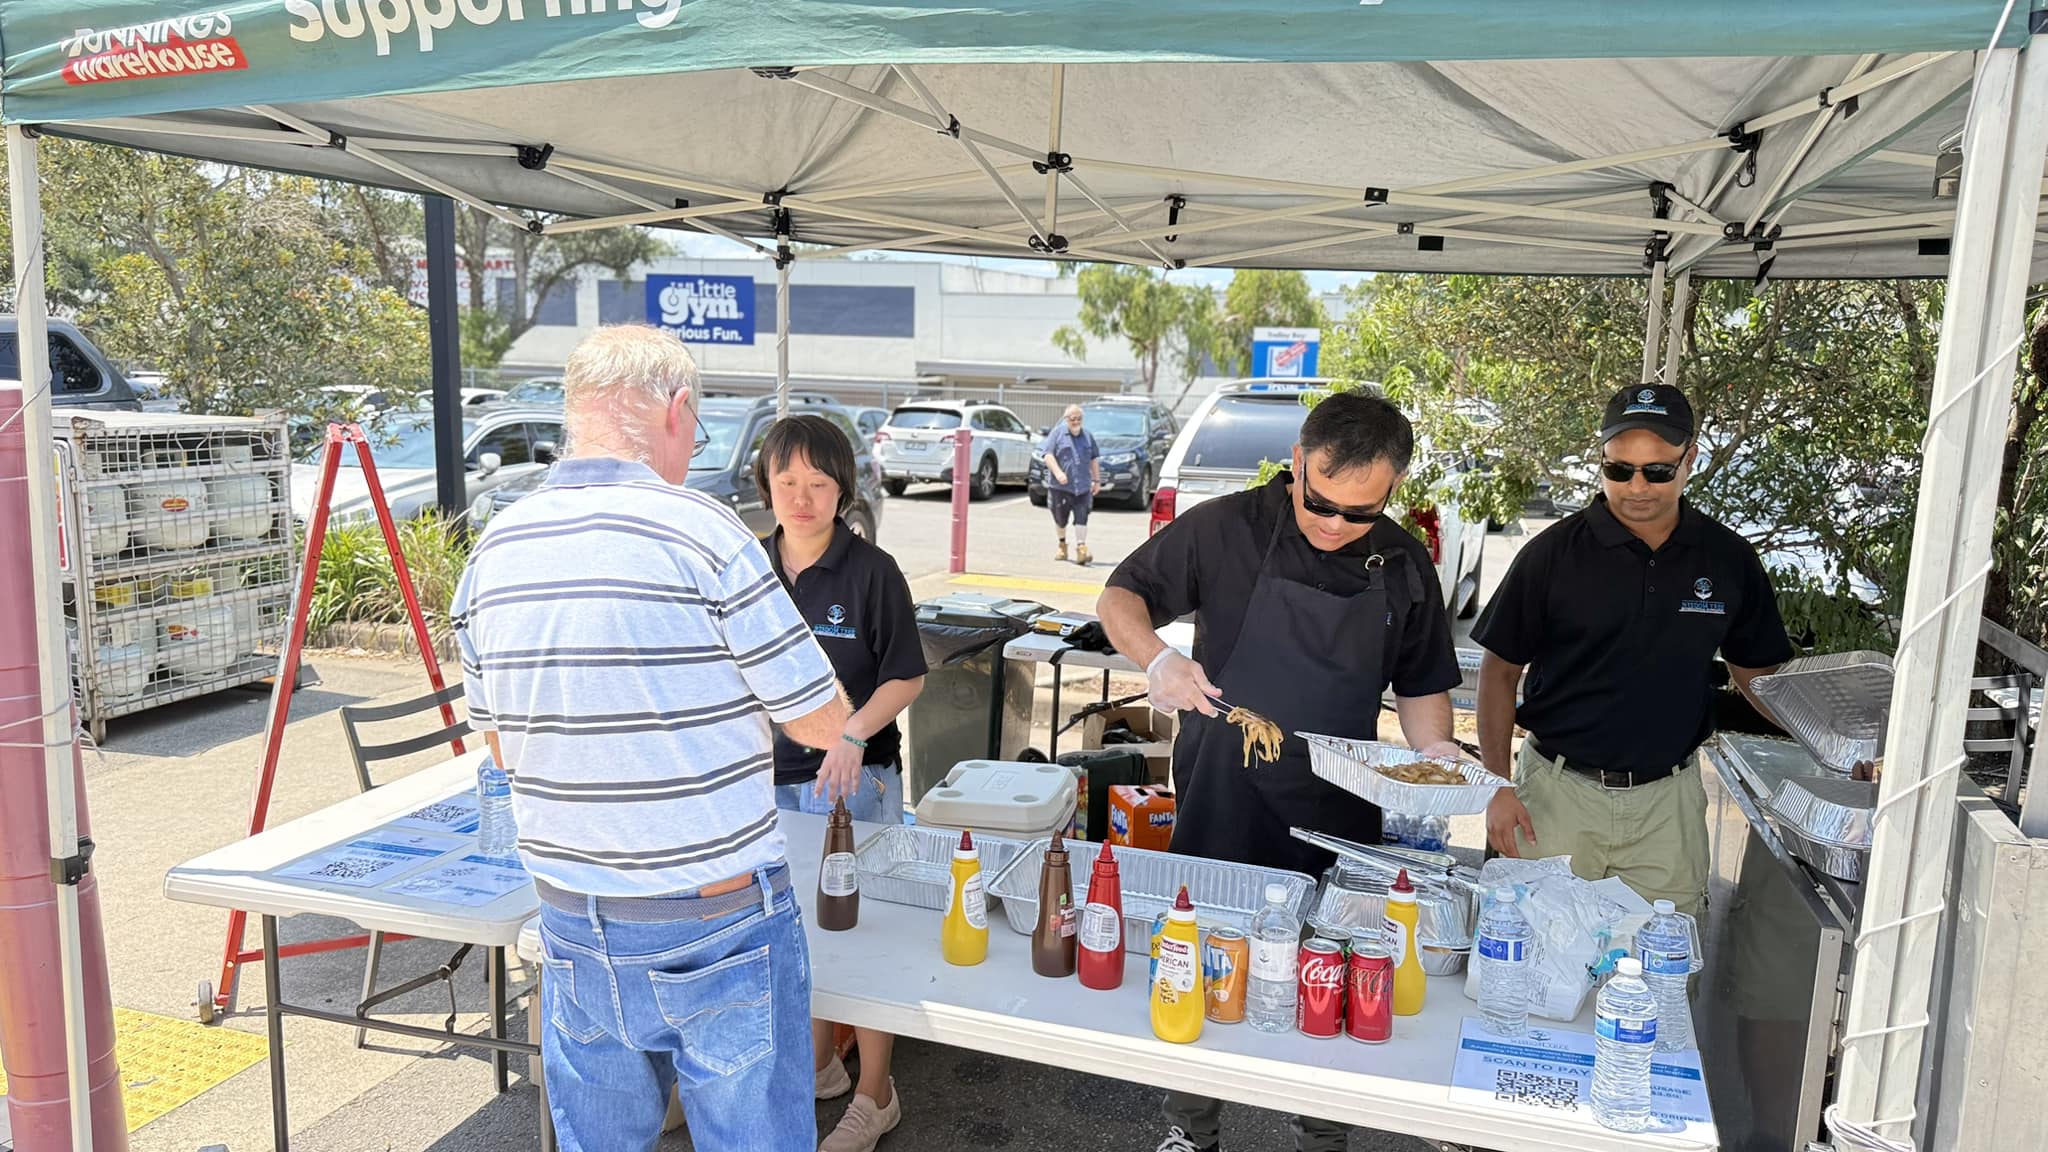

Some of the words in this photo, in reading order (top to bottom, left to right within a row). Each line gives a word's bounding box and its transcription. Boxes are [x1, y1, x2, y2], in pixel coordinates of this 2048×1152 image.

[289, 0, 682, 56] suppo
[72, 40, 236, 82] warehouse
[691, 279, 737, 299] Little
[713, 327, 743, 341] Fun.
[1160, 955, 1190, 969] ERICAN
[1301, 957, 1345, 988] Coca
[1483, 1056, 1526, 1068] SCAN
[1532, 1063, 1553, 1071] TO
[1558, 1067, 1590, 1077] PAY
